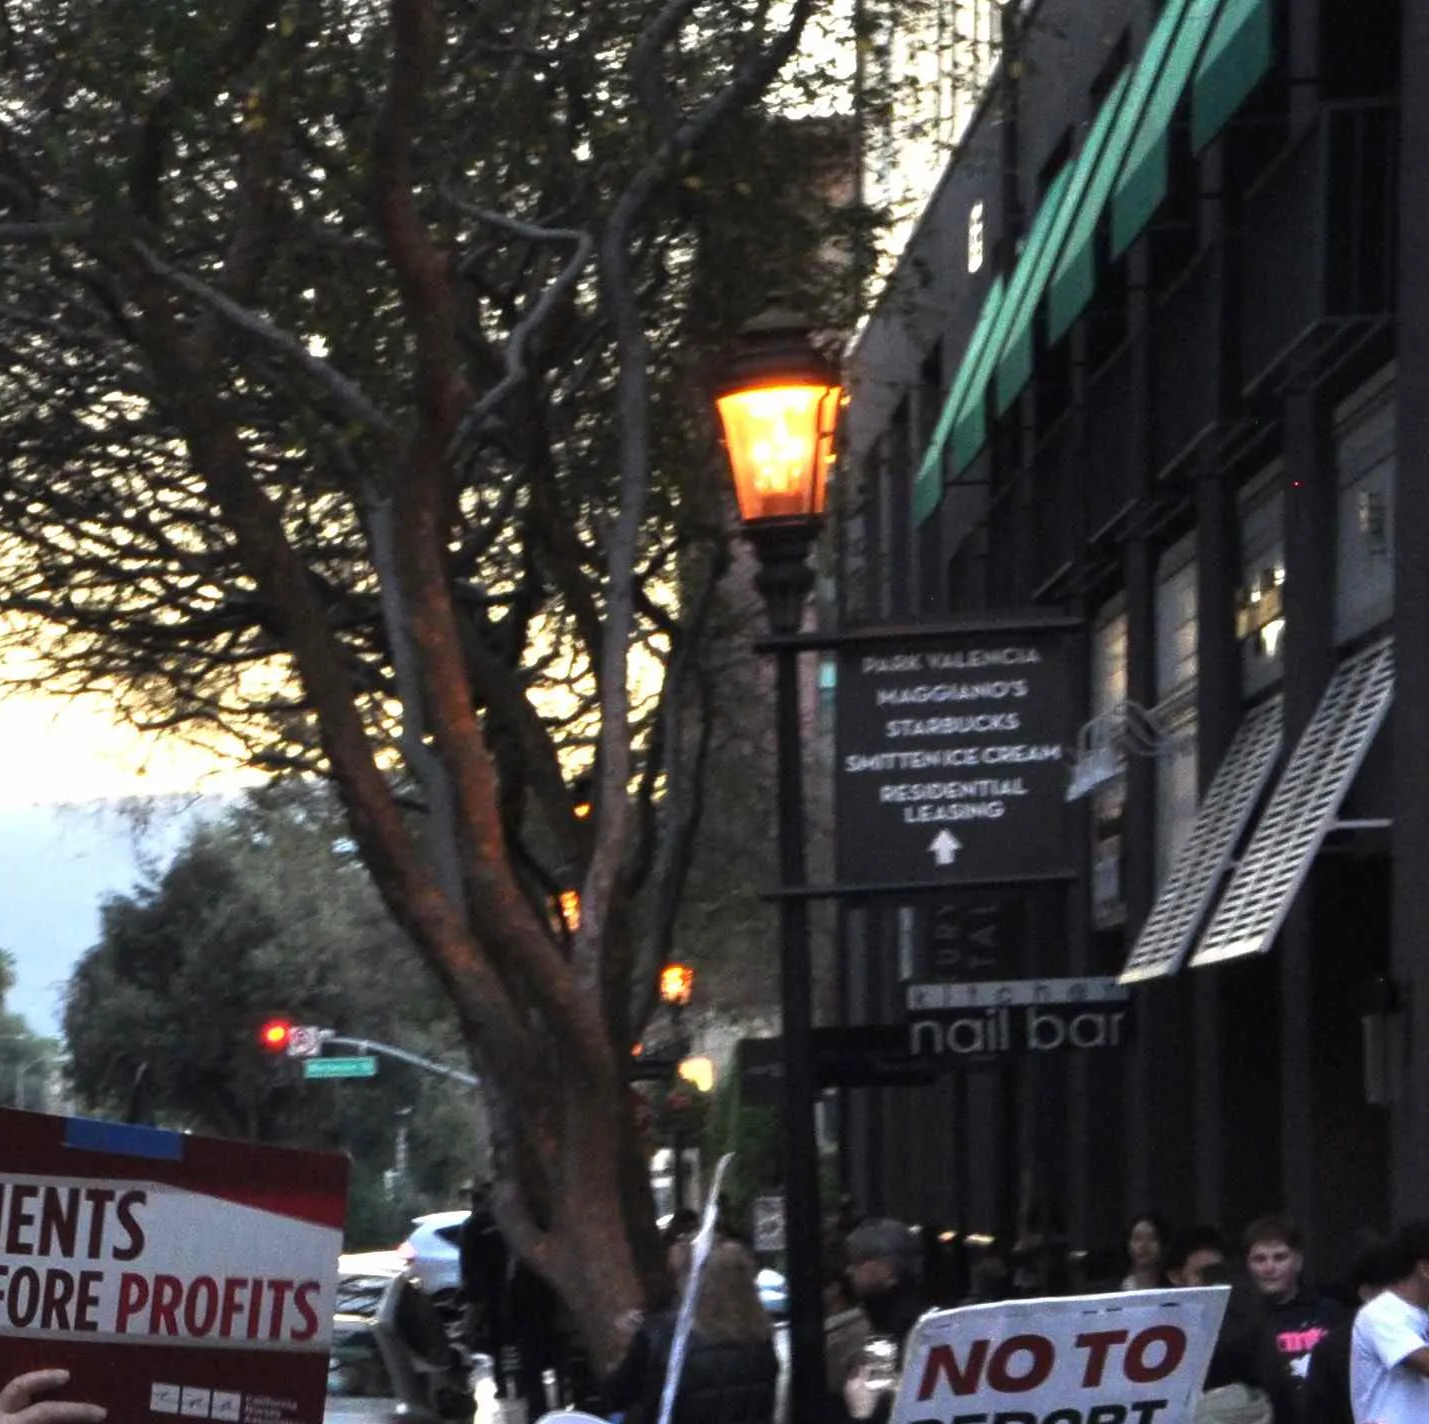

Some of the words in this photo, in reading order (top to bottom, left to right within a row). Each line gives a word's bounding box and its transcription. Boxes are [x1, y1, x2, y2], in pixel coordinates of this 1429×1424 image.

[876, 680, 1028, 706] MAGGIANO'S
[885, 712, 1021, 738] STARBUCKS
[943, 748, 979, 768] ICE
[982, 744, 1063, 765] CREAM
[879, 777, 1029, 803] RESIDENTIAL
[903, 800, 1006, 824] LEASING
[909, 1008, 1010, 1055] nail
[1026, 1006, 1125, 1049] bar
[115, 1271, 321, 1343] PROFITS
[917, 1332, 1055, 1401] NO
[1075, 1325, 1187, 1388] TO
